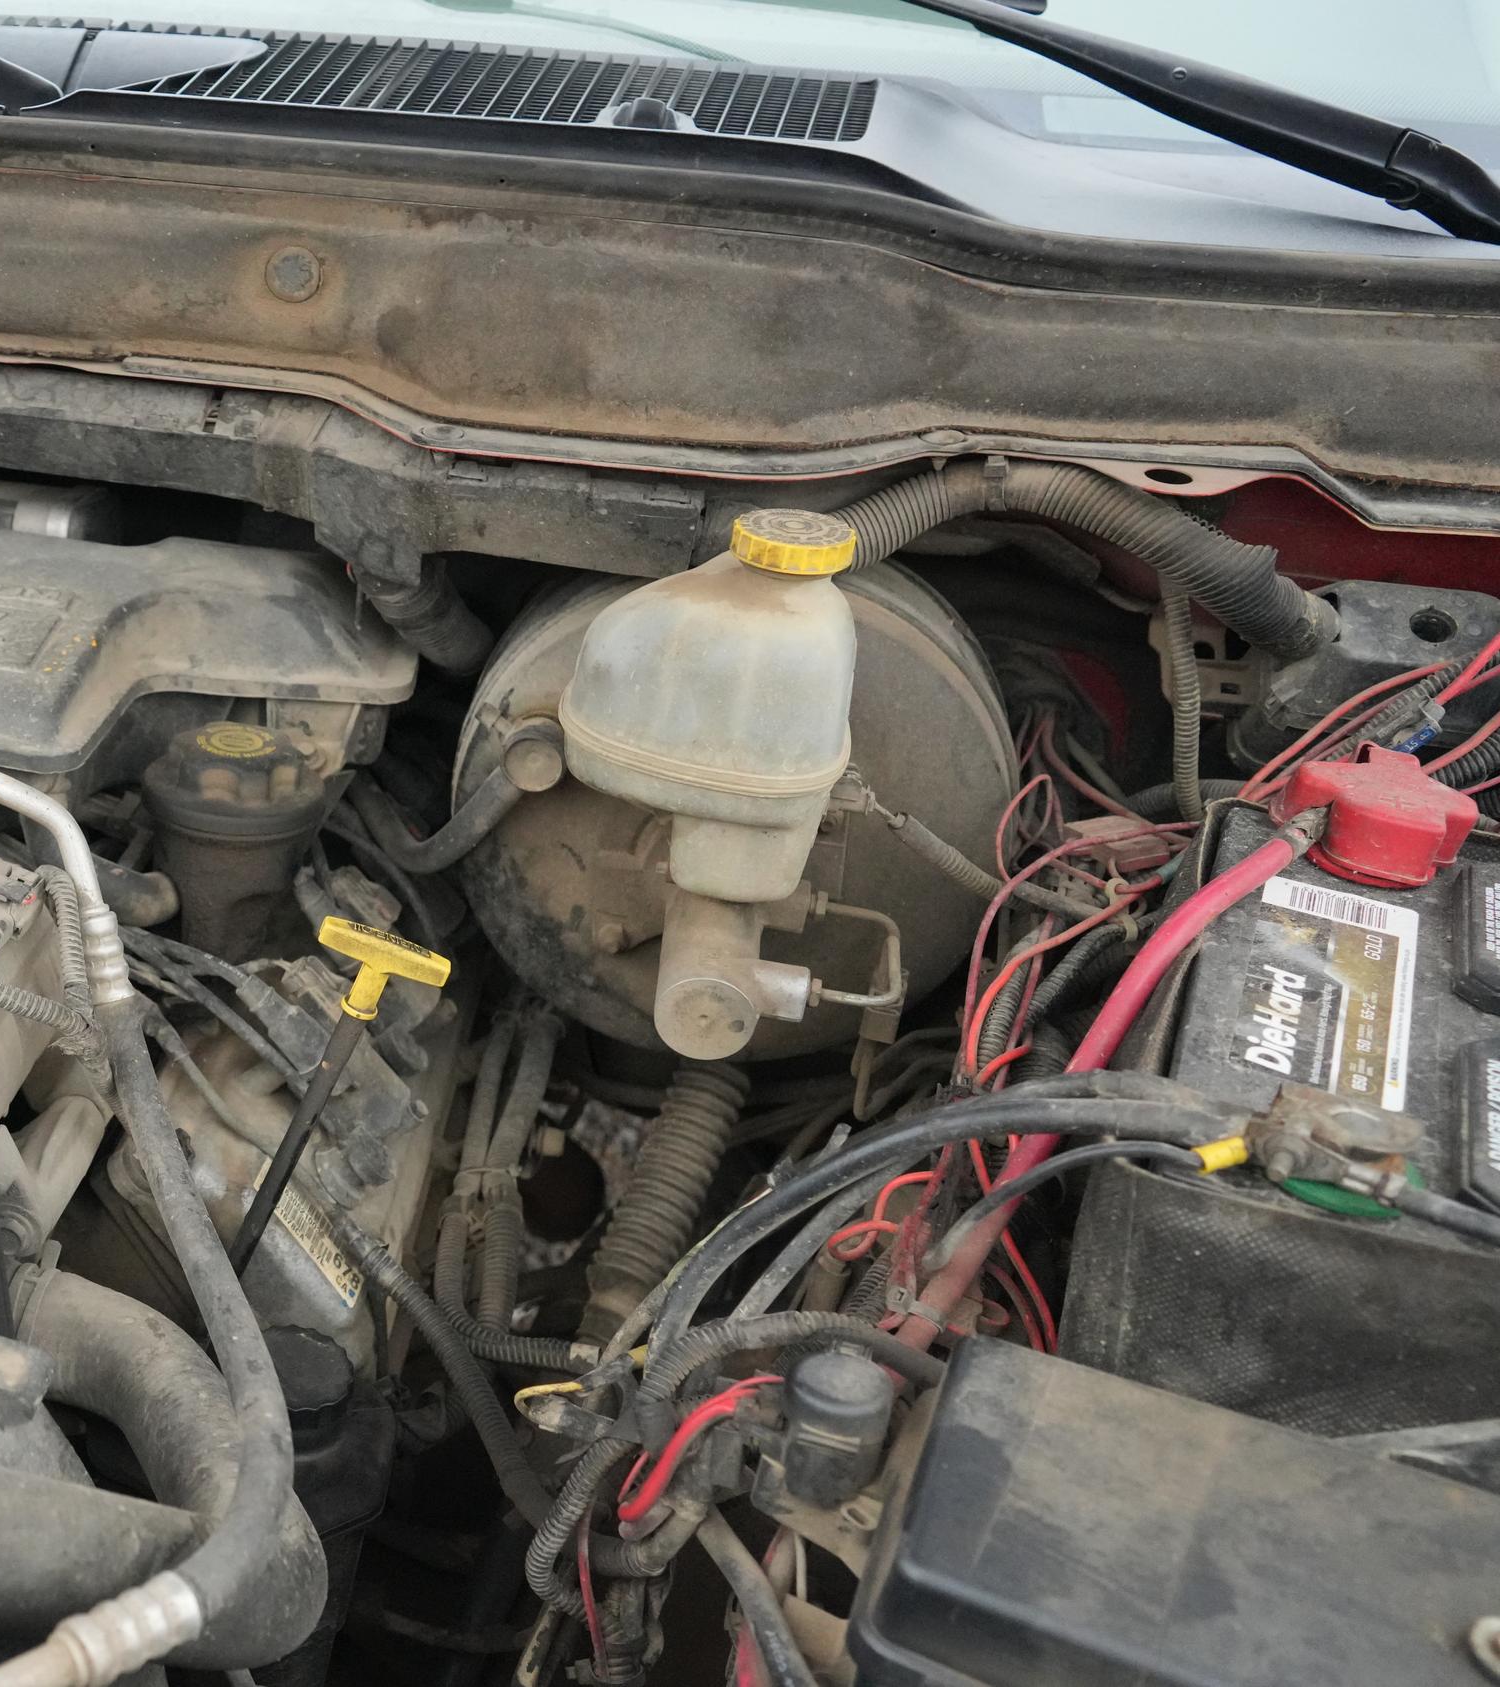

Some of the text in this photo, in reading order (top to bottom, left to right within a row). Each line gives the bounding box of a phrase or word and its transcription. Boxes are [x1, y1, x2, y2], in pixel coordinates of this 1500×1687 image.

[1364, 934, 1383, 961] GOLD
[1244, 964, 1306, 1075] DieHard
[333, 1253, 360, 1290] 678
